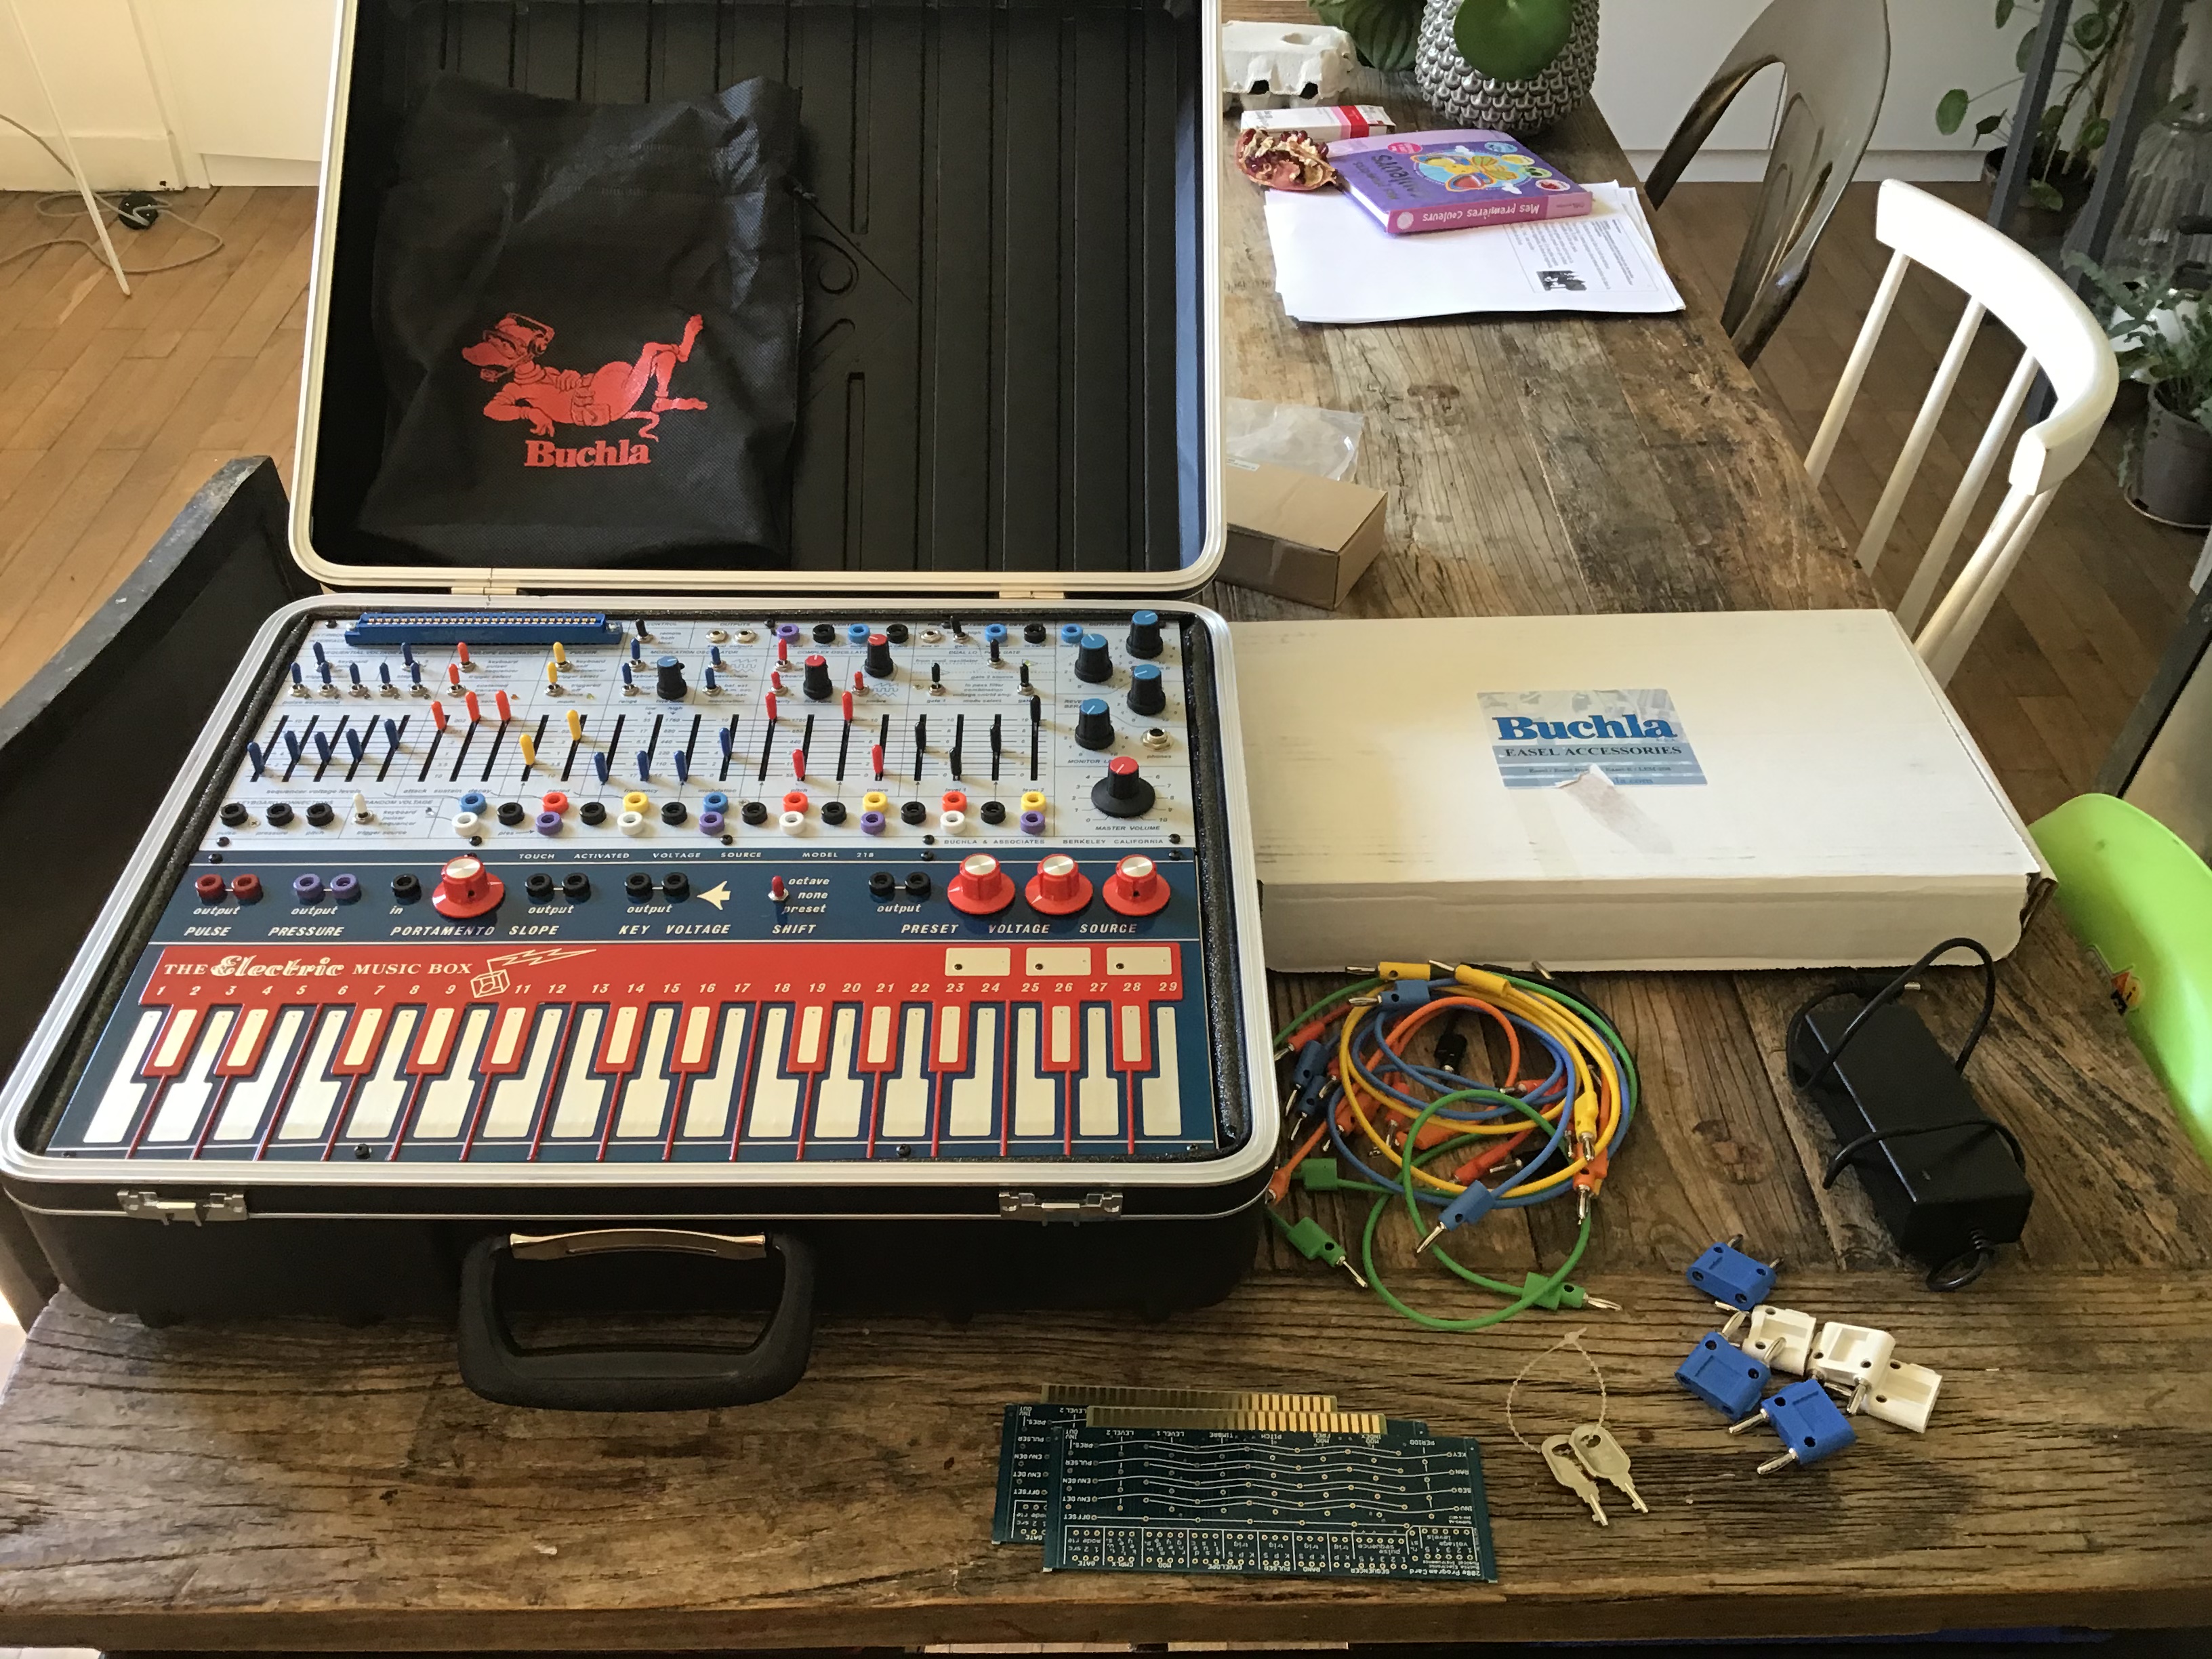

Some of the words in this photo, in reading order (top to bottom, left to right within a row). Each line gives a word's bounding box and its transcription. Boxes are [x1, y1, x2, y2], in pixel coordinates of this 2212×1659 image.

[1467, 203, 1516, 220] premières
[1519, 204, 1540, 214] Mes
[524, 439, 651, 468] Buchla
[1492, 714, 1678, 740] Buchla
[1505, 747, 1560, 756] EASEL
[1565, 746, 1682, 756] ACCESSORIES
[788, 876, 830, 886] octave
[798, 890, 828, 899] none
[193, 906, 241, 916] output
[291, 905, 339, 916] output
[389, 906, 404, 915] in
[527, 904, 575, 915] output
[627, 903, 673, 915] output
[781, 904, 827, 915] preset
[876, 903, 921, 915] output
[183, 926, 232, 937] PULSE
[268, 926, 345, 937] PRESSURE
[390, 925, 495, 937] PORTAMENTO
[509, 925, 560, 935] SLOPE
[618, 924, 651, 935] KEY
[665, 924, 731, 935] VOLTAGE
[772, 924, 817, 935] SHIFT
[901, 924, 959, 934] PRESET
[988, 924, 1050, 934] VOLTAGE
[1079, 923, 1136, 933] SOURCE
[164, 964, 208, 975] THE
[210, 954, 345, 977] Electric
[352, 963, 422, 975] MUSIC
[427, 962, 473, 975] BOX
[157, 987, 165, 996] 1
[189, 986, 201, 996] 2
[225, 985, 237, 995] 3
[262, 985, 273, 995] 4
[296, 985, 308, 995] 5
[337, 985, 348, 995] 6
[374, 985, 385, 995] 7
[409, 985, 420, 994] 8
[445, 984, 456, 994] 9
[514, 983, 531, 994] 11
[548, 983, 567, 994] 12
[591, 983, 609, 994] 13
[627, 983, 645, 994] 14
[662, 983, 681, 994] 15
[699, 983, 716, 994] 16
[734, 983, 751, 993] 17
[773, 983, 791, 993] 18
[808, 983, 826, 993] 19
[842, 983, 862, 993] 20
[876, 982, 895, 993] 21
[910, 982, 930, 993] 22
[945, 982, 964, 993] 23
[981, 982, 1000, 993] 24
[1021, 982, 1040, 993] 25
[1054, 982, 1073, 993] 26
[1090, 982, 1108, 993] 27
[1123, 982, 1141, 992] 28
[1159, 981, 1177, 992] 29
